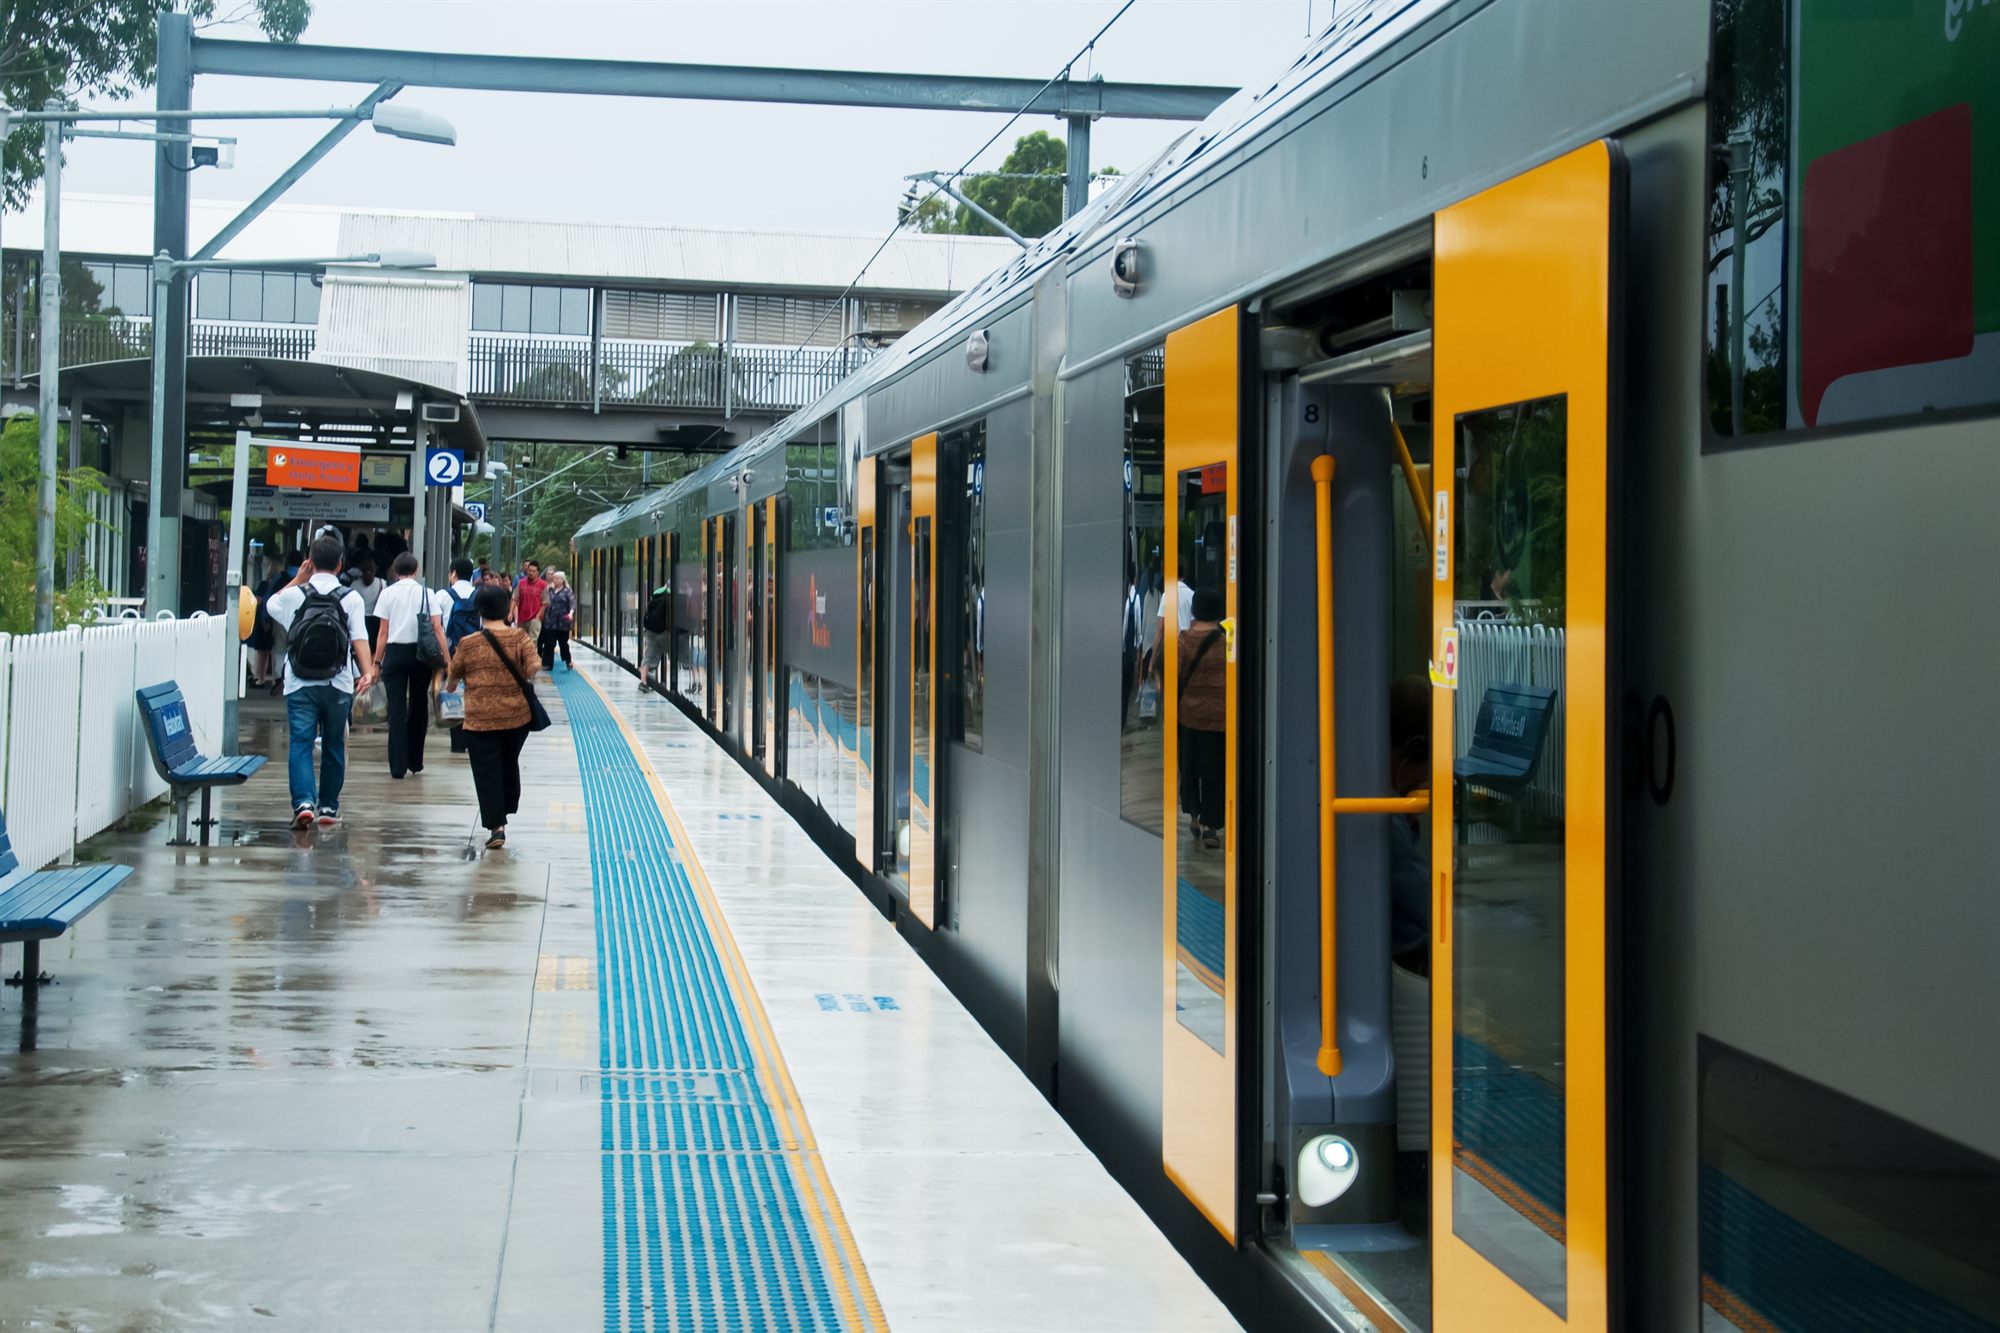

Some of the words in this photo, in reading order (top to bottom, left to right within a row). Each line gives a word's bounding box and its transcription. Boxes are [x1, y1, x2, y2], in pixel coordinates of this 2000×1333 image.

[1422, 155, 1428, 180] 6
[1304, 404, 1319, 424] 8
[436, 455, 452, 479] 2
